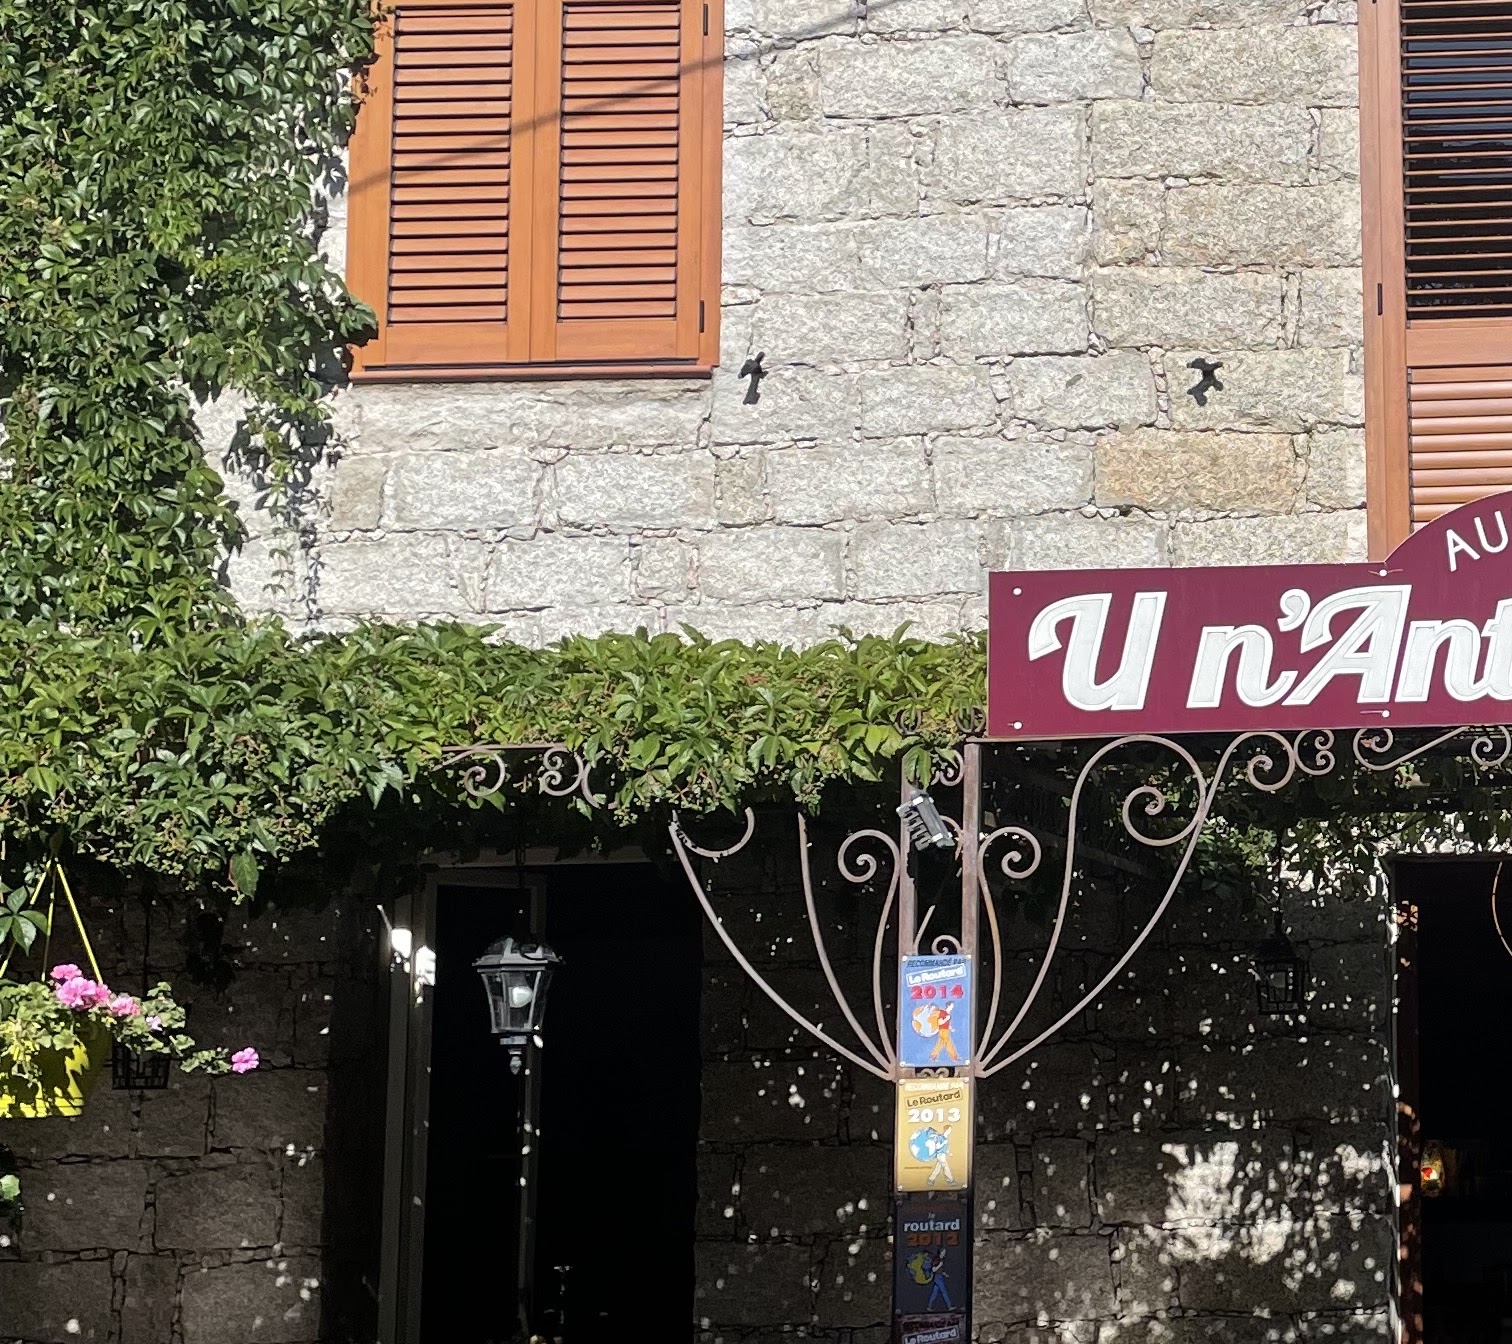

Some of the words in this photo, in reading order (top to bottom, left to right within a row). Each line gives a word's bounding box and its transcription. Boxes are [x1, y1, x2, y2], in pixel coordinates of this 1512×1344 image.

[1028, 591, 1168, 713] U
[908, 975, 921, 985] Le
[921, 967, 964, 982] Routard
[911, 984, 964, 1000] 2014
[906, 1099, 919, 1108] Le
[919, 1090, 961, 1105] Routard
[907, 1107, 961, 1123] 2013
[903, 1218, 961, 1232] routard
[905, 1232, 960, 1247] 2012
[917, 1328, 957, 1344] Routard
